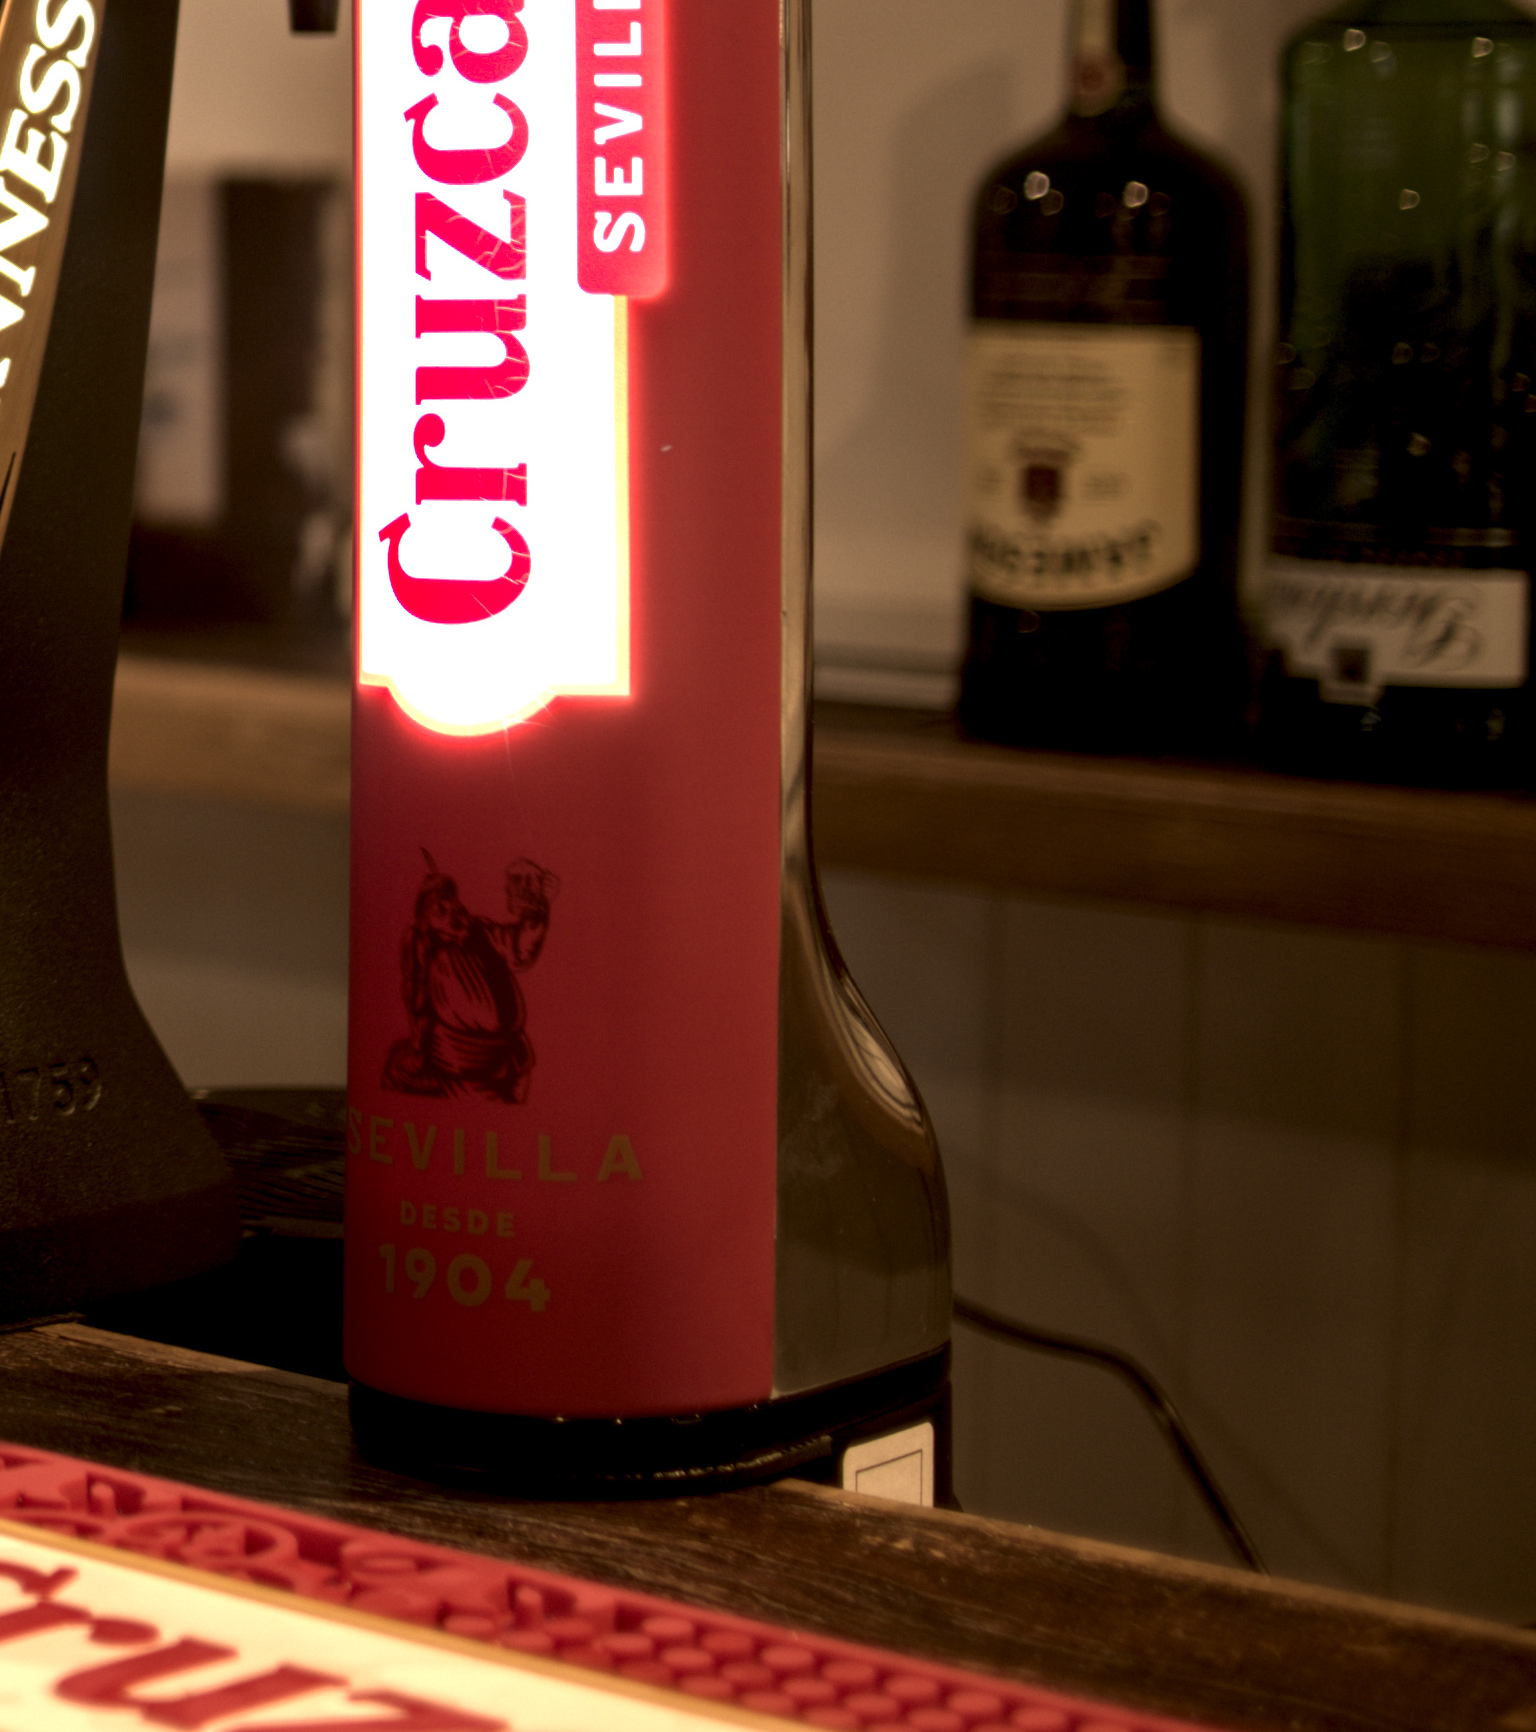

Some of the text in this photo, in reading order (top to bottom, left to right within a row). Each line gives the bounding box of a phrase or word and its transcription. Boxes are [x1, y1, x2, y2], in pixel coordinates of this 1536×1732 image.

[347, 1104, 645, 1182] SEVILLA
[399, 1199, 517, 1238] DESDE
[378, 1242, 551, 1313] 1904
